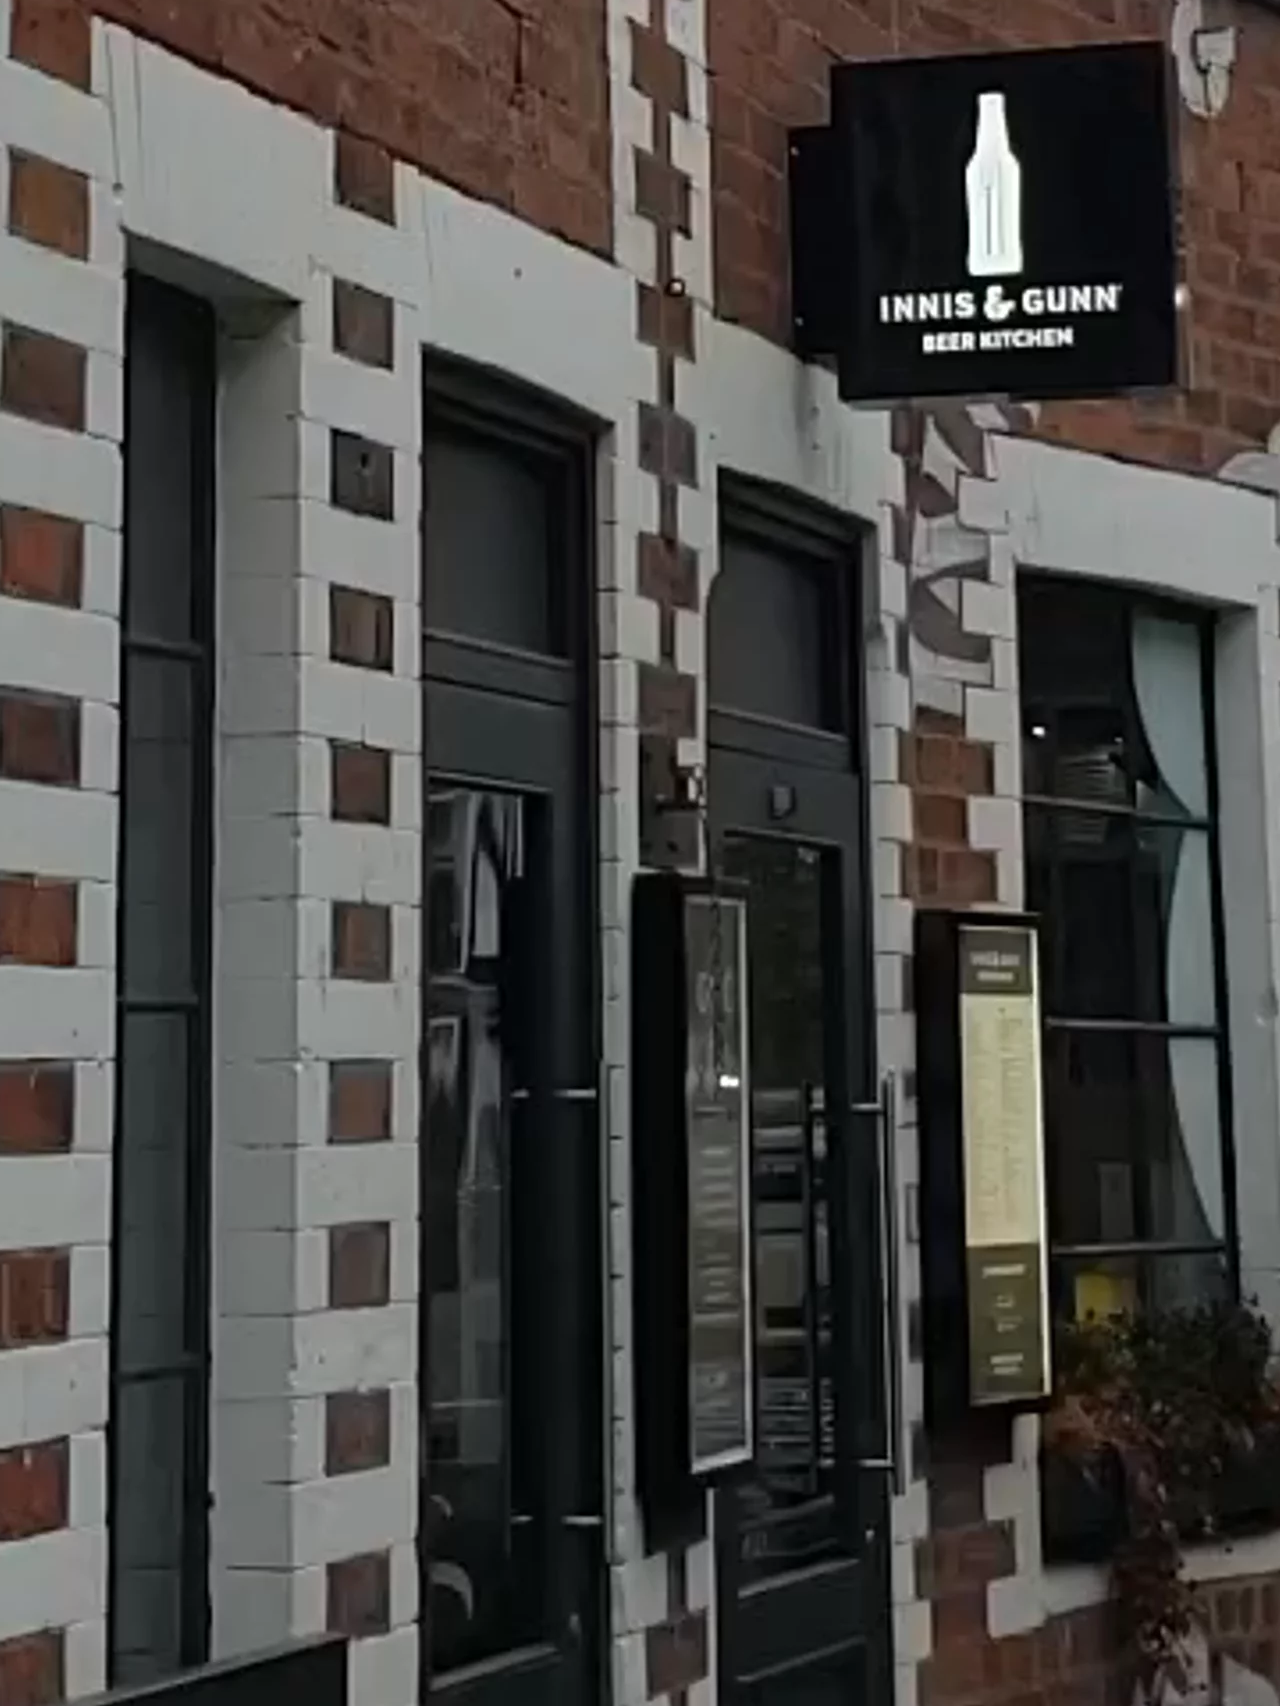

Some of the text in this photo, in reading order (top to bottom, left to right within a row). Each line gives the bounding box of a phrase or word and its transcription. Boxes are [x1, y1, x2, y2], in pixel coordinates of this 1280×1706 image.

[879, 284, 1118, 323] INNIS & GUNN
[922, 326, 1074, 354] BEER KITCHEN
